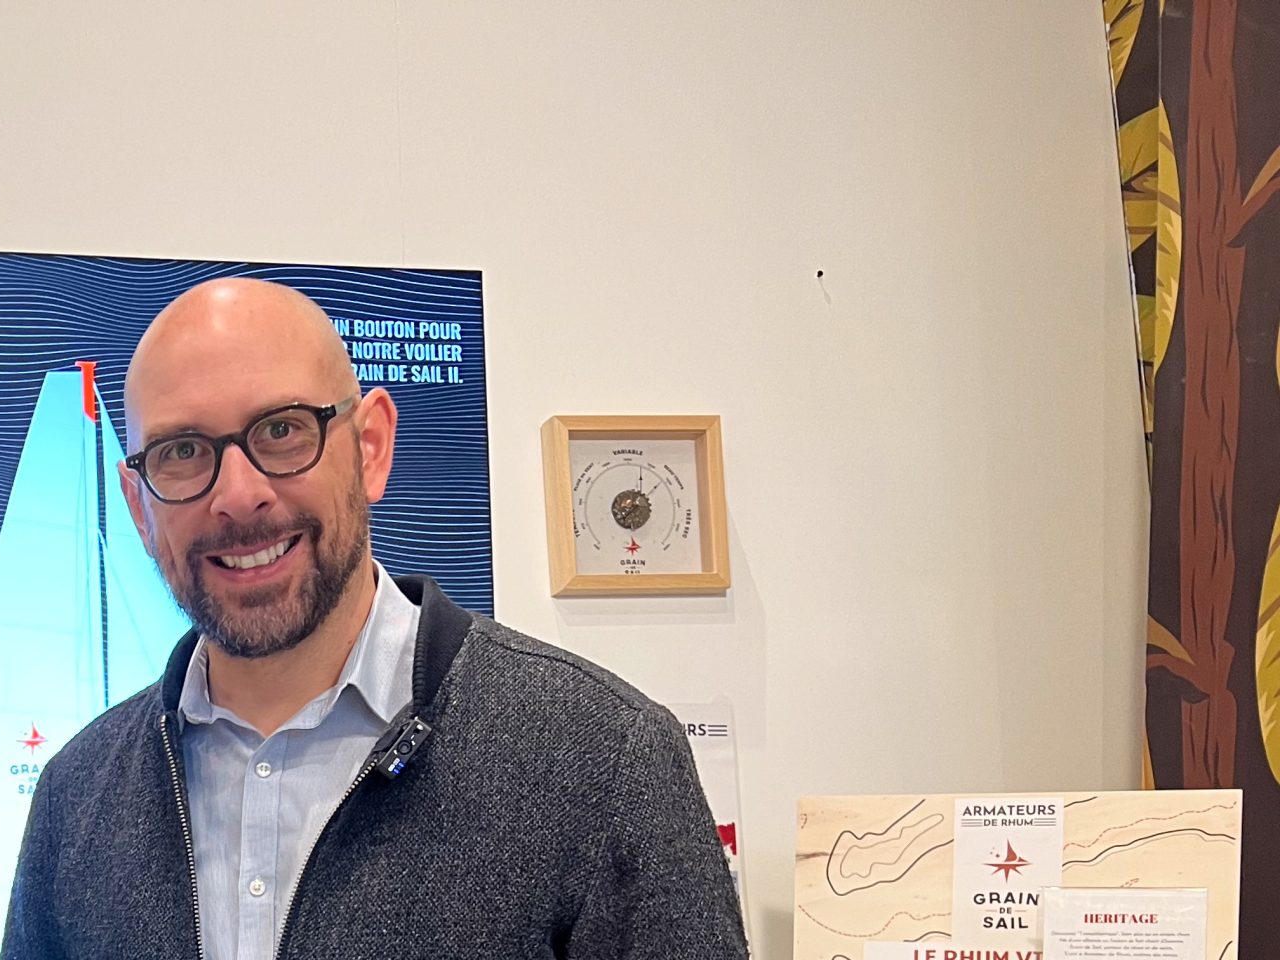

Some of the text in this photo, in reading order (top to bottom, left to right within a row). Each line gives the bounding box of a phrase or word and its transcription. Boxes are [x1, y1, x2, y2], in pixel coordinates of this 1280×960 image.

[354, 319, 415, 338] BOUTON
[420, 322, 462, 340] POUR
[353, 341, 401, 360] NOTRE
[404, 343, 462, 362] VOILIER
[388, 364, 408, 382] DE
[411, 365, 444, 383] SAIL
[448, 366, 463, 384] II.
[10, 763, 40, 775] GRA
[962, 804, 1056, 816] ARMATEURS
[983, 818, 1033, 827] DE RHUM
[973, 891, 1040, 906] GRAIN
[999, 906, 1012, 914] DE
[983, 916, 1029, 929] SAIL
[1084, 913, 1158, 924] HERITAGE
